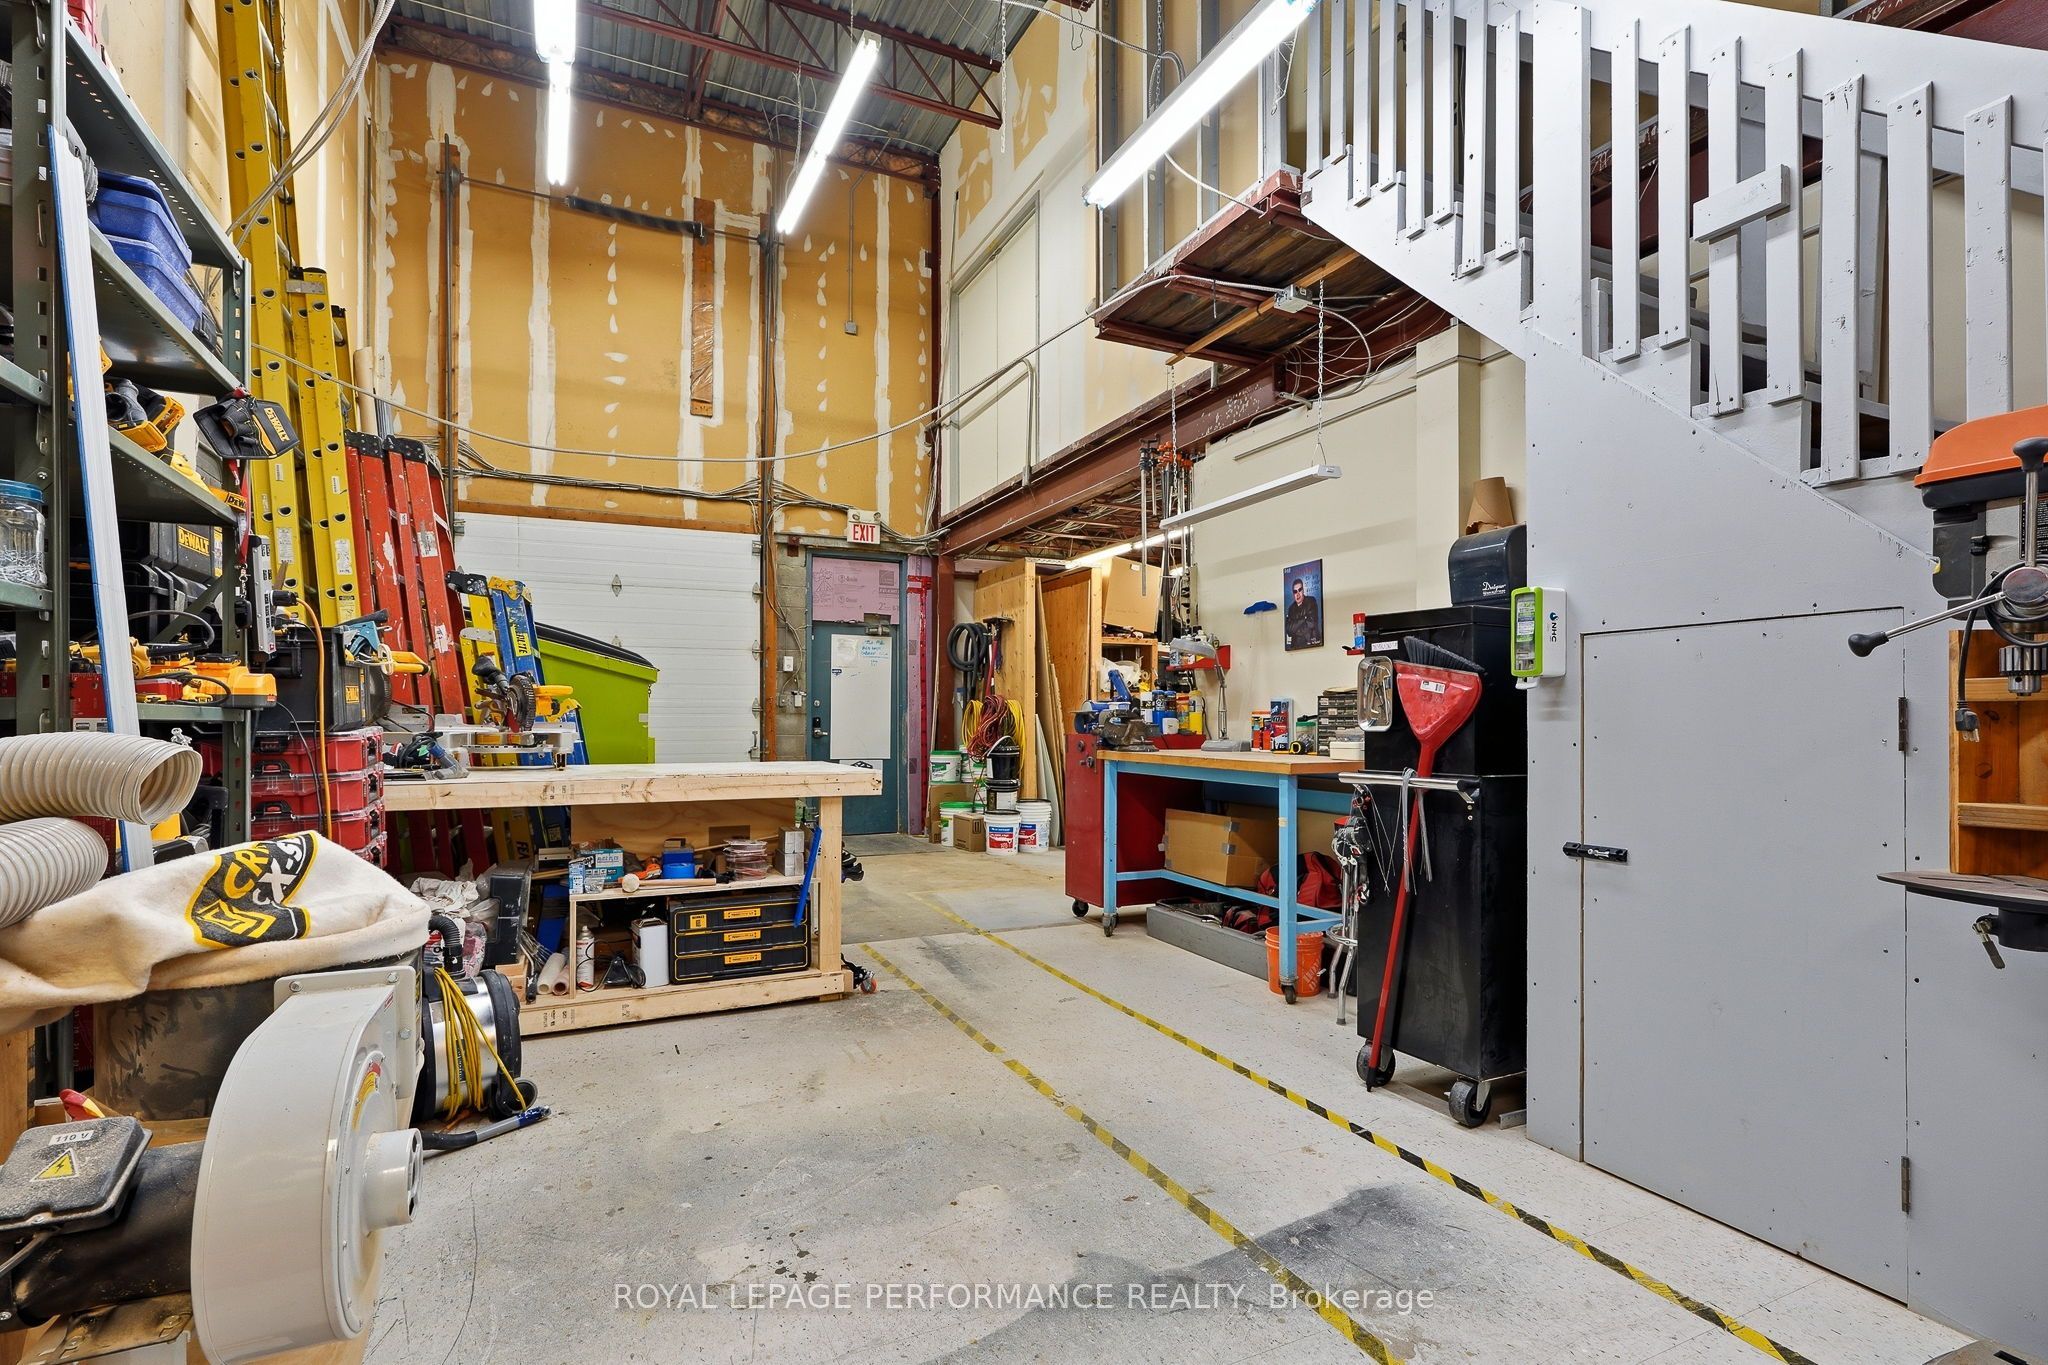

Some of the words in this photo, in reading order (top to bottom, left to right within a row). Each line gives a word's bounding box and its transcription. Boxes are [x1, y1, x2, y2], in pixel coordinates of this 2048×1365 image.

[179, 528, 210, 554] DEWALT
[853, 524, 876, 542] EXIT
[56, 1134, 77, 1142] 110
